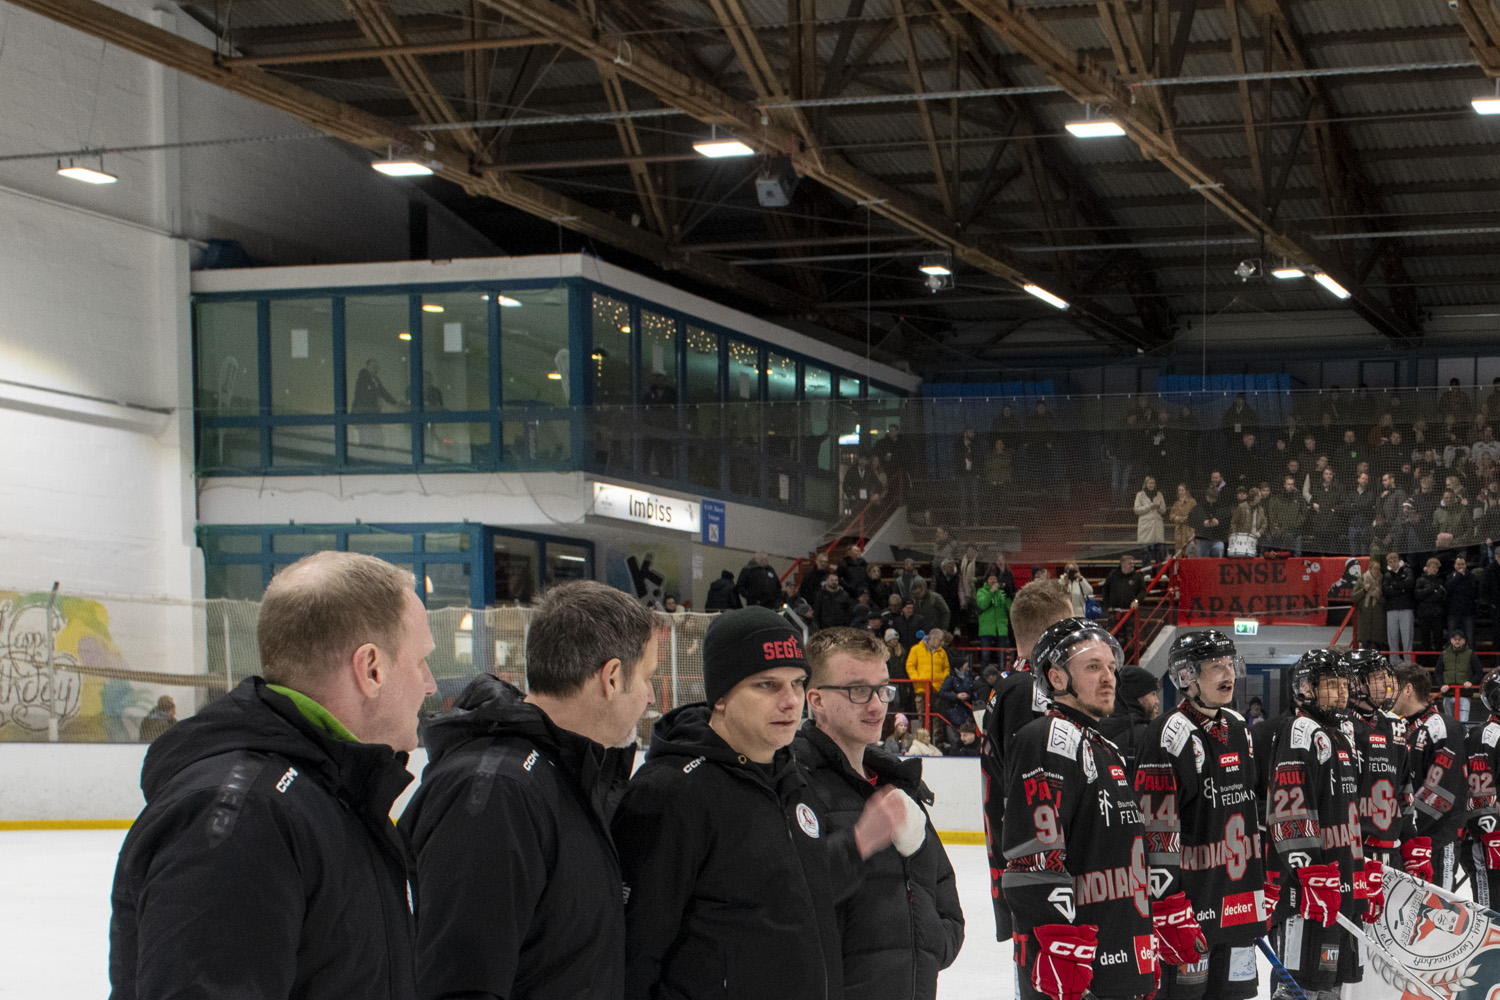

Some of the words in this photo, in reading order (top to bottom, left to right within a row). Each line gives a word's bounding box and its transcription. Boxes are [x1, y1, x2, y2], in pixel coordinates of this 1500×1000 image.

[628, 494, 672, 523] Imbiss
[1218, 562, 1288, 585] ENSE
[1186, 594, 1319, 618] APACHEN
[523, 750, 540, 771] CCM
[683, 755, 706, 773] CCM
[1221, 755, 1239, 764] CCM
[276, 767, 298, 793] CCM
[1468, 772, 1493, 794] 92
[1273, 786, 1307, 819] 22
[1224, 903, 1253, 916] decker
[1100, 952, 1128, 966] dach
